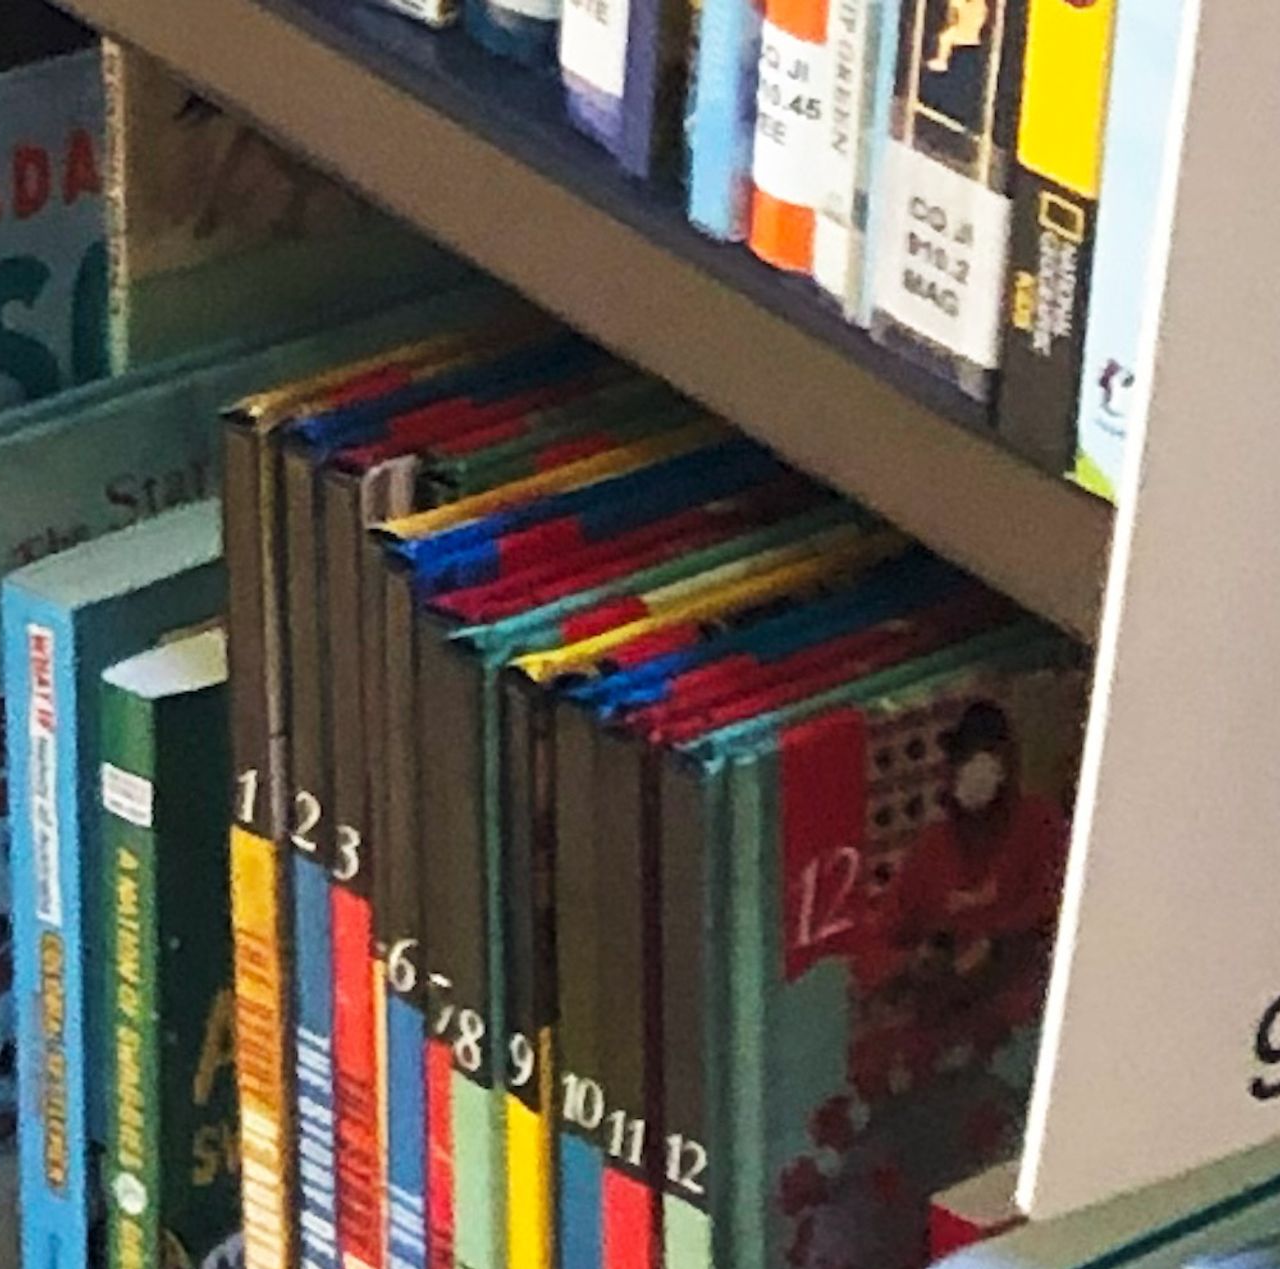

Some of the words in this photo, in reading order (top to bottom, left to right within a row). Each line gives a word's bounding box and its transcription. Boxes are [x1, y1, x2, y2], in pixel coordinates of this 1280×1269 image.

[237, 768, 258, 823] 1
[290, 789, 322, 851] 2
[332, 824, 363, 881] 3
[796, 845, 862, 948] 12
[385, 937, 420, 993] 6
[297, 1027, 332, 1095] THE
[455, 1007, 487, 1072] 8
[509, 1031, 537, 1088] 9
[561, 1073, 605, 1130] 10
[298, 1096, 336, 1211] STORY
[606, 1109, 647, 1167] 11
[664, 1131, 709, 1195] 12
[301, 1210, 339, 1259] OF
[388, 1184, 424, 1254] THE
